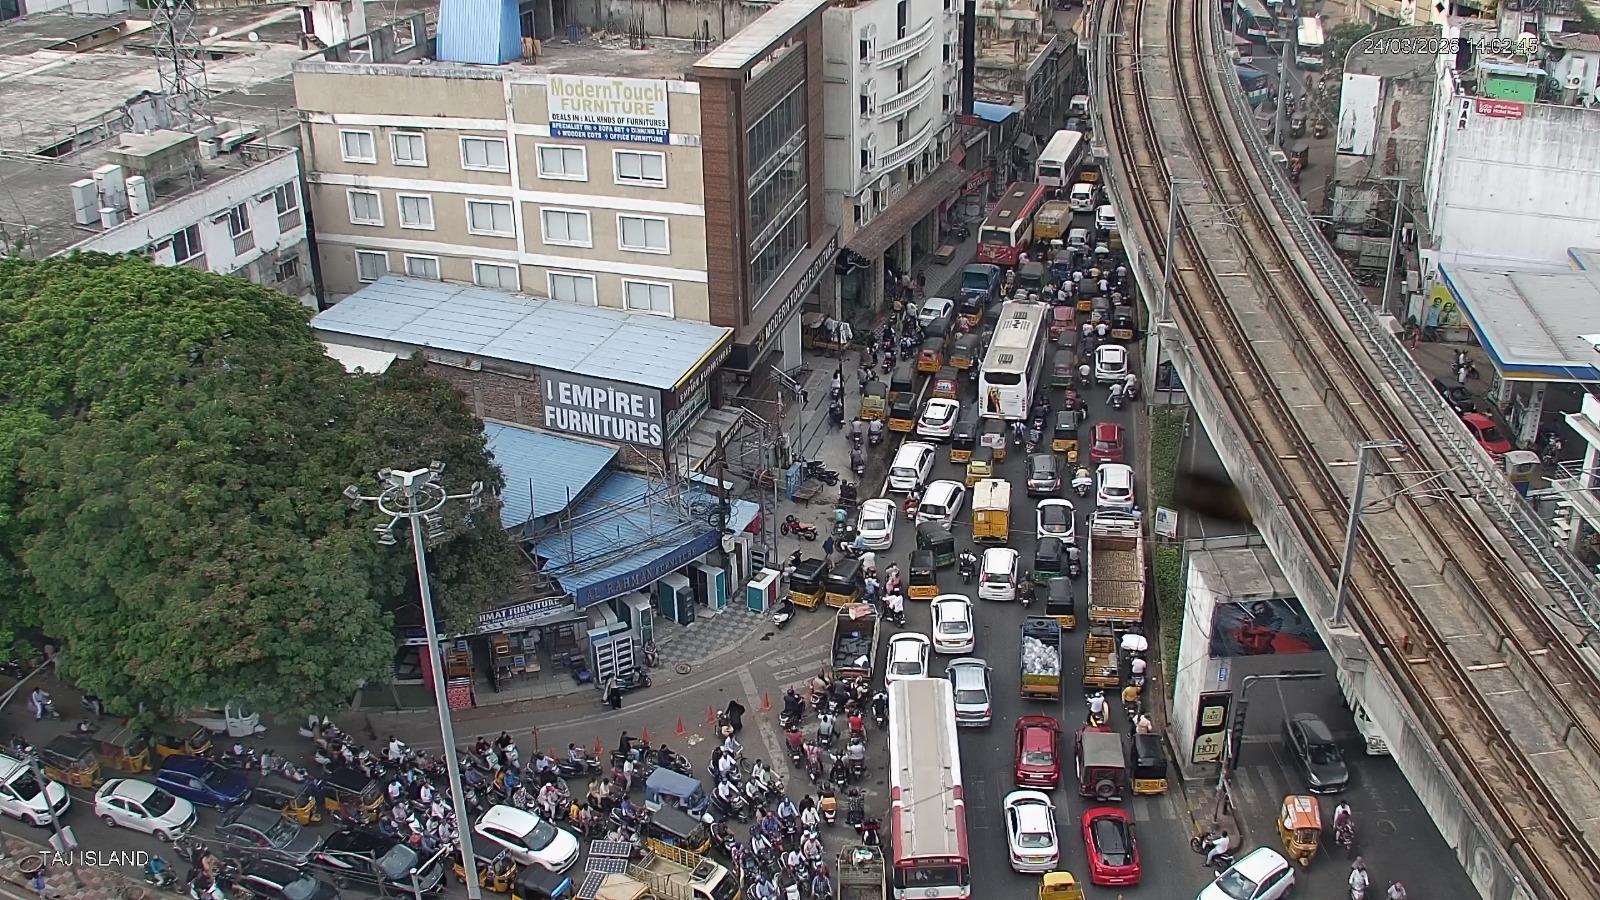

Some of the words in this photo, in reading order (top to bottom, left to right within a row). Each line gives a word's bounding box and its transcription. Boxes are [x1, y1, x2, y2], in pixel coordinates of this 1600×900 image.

[561, 98, 655, 115] FURNITURE
[1458, 100, 1470, 129] BAR
[552, 113, 571, 121] DEALS
[585, 115, 595, 123] ALL
[596, 116, 615, 124] KINDS
[616, 117, 625, 125] OF
[626, 117, 666, 127] FURNITURES
[609, 133, 629, 141] OFFICE
[765, 298, 790, 340] MODERN
[789, 276, 809, 307] TOUCH
[808, 238, 836, 283] FURNITURE
[558, 382, 645, 418] EMPIRE
[544, 405, 662, 446] FURNITURES
[607, 567, 654, 594] RAHMAN
[655, 549, 697, 575] FURNITURE
[508, 599, 560, 615] FURNITURE
[1197, 743, 1218, 753] HOT
